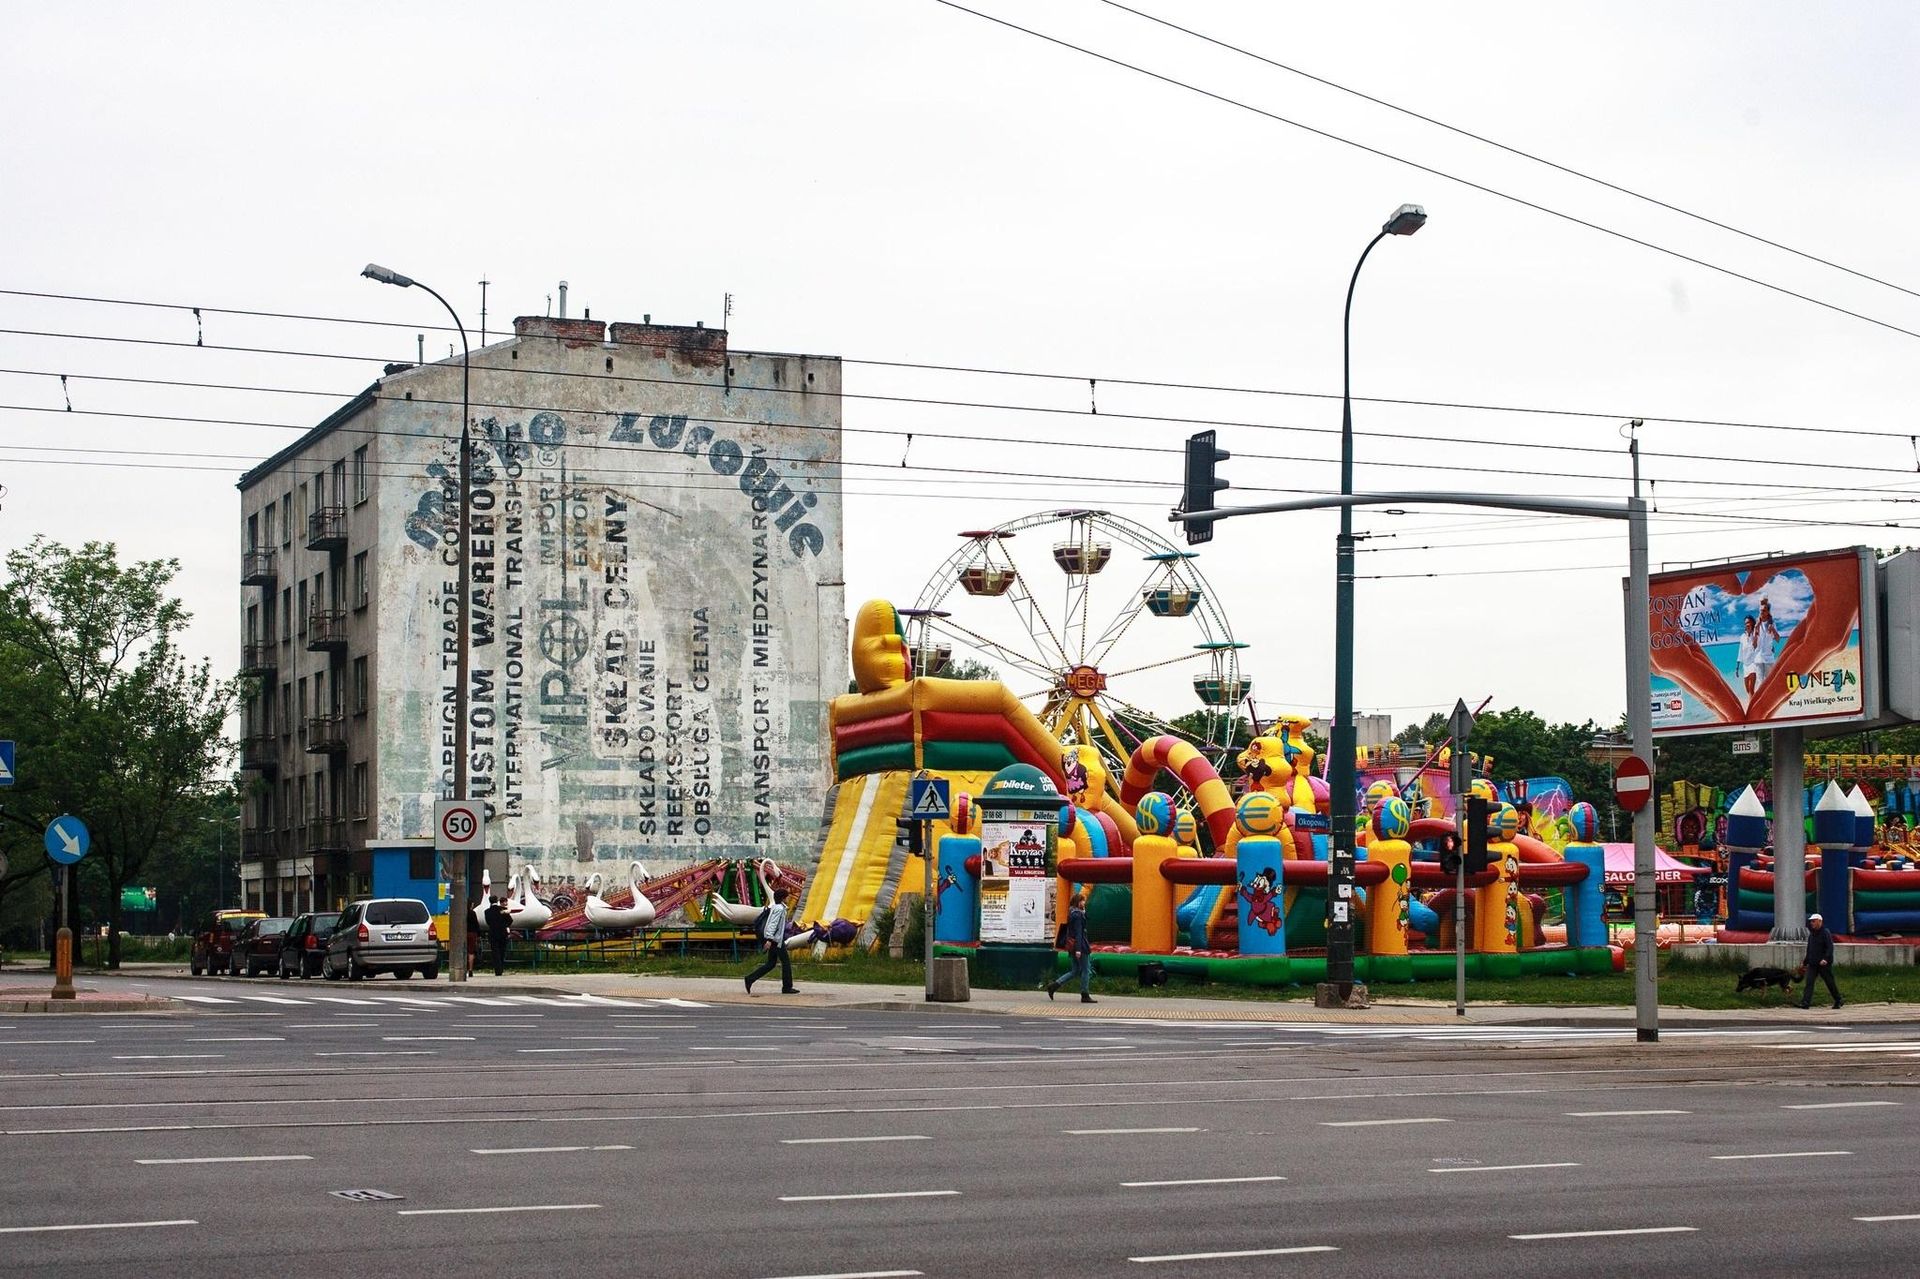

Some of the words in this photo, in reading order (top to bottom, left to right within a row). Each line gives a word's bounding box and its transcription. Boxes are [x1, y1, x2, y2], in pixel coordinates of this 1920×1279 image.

[505, 425, 523, 590] TRANSPORT
[540, 472, 556, 566] IMPORT
[572, 471, 588, 567] EXPORT
[603, 495, 629, 610] CELNY
[442, 580, 459, 671] TRADE
[693, 606, 710, 693] CELNA
[1662, 610, 1721, 631] NASZYM
[505, 606, 523, 818] INTERNATIONAL
[604, 629, 629, 748] SKŁAD
[1067, 674, 1105, 689] MEGA
[752, 684, 771, 844] TRANSPORT
[1003, 780, 1035, 791] bileter
[1733, 742, 1752, 751] ams
[449, 817, 472, 834] 50
[1605, 872, 1635, 882] SALO
